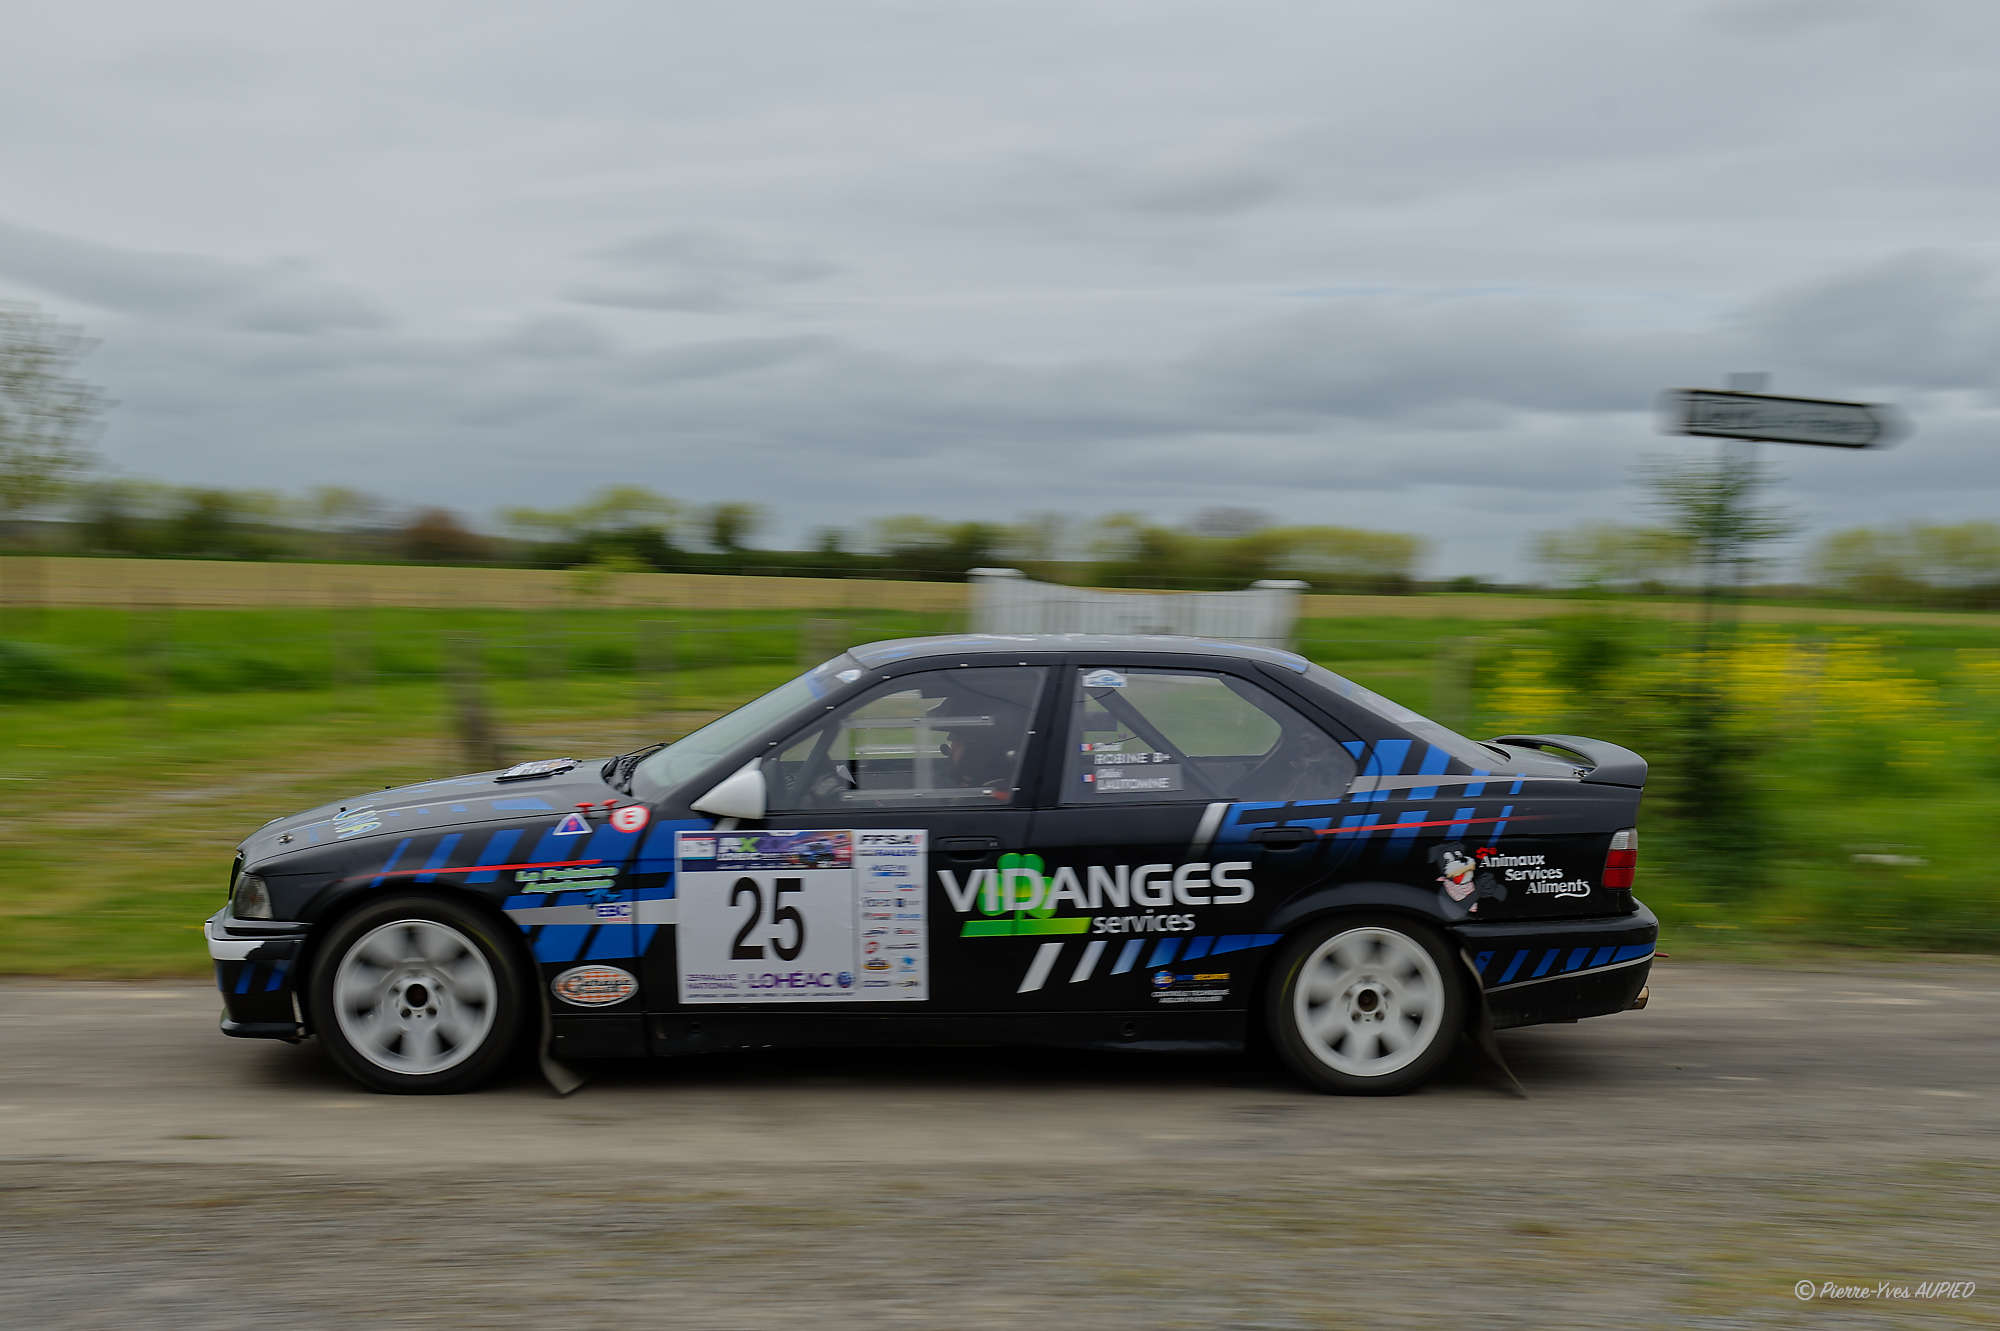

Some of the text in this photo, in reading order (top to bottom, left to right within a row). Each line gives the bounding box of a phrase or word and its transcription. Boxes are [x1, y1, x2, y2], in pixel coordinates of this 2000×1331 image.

[1094, 752, 1148, 765] ROBINE
[859, 834, 914, 845] FFSA
[1479, 854, 1546, 868] Animaux
[1505, 867, 1564, 881] Services
[936, 860, 1256, 913] VIDANGES
[1525, 879, 1591, 898] Aliments
[596, 905, 632, 918] EBC
[729, 876, 804, 962] 25
[1092, 909, 1197, 935] services
[748, 970, 833, 989] LOHÉAC
